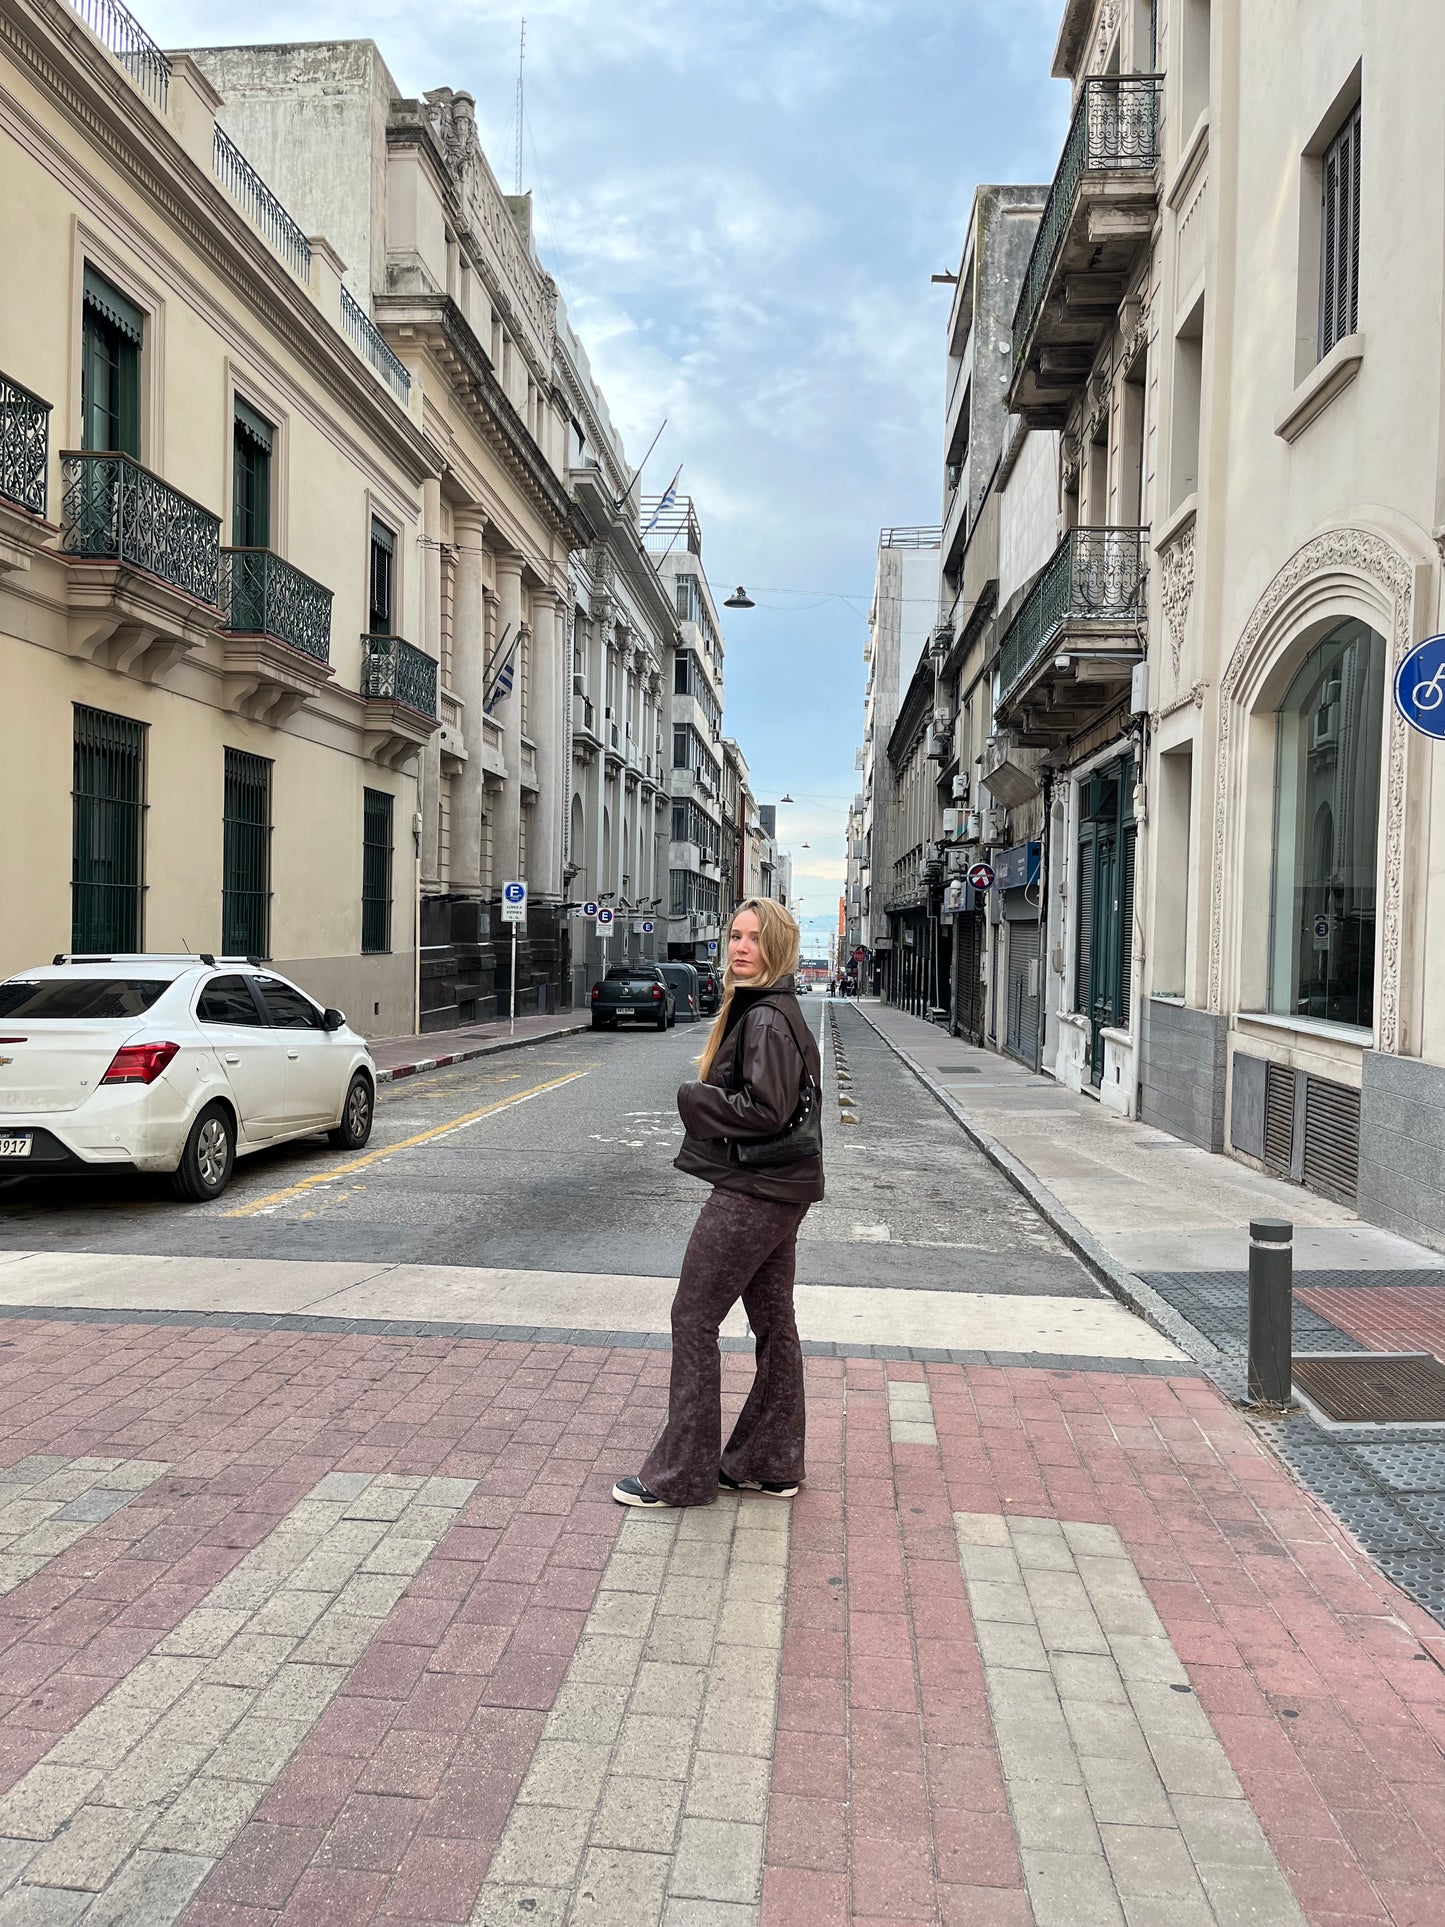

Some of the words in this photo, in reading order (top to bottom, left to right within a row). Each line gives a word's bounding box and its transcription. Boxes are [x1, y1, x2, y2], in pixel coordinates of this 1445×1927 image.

[510, 886, 520, 897] E
[587, 905, 594, 913] E
[601, 912, 609, 921] E
[0, 1140, 26, 1153] 917
